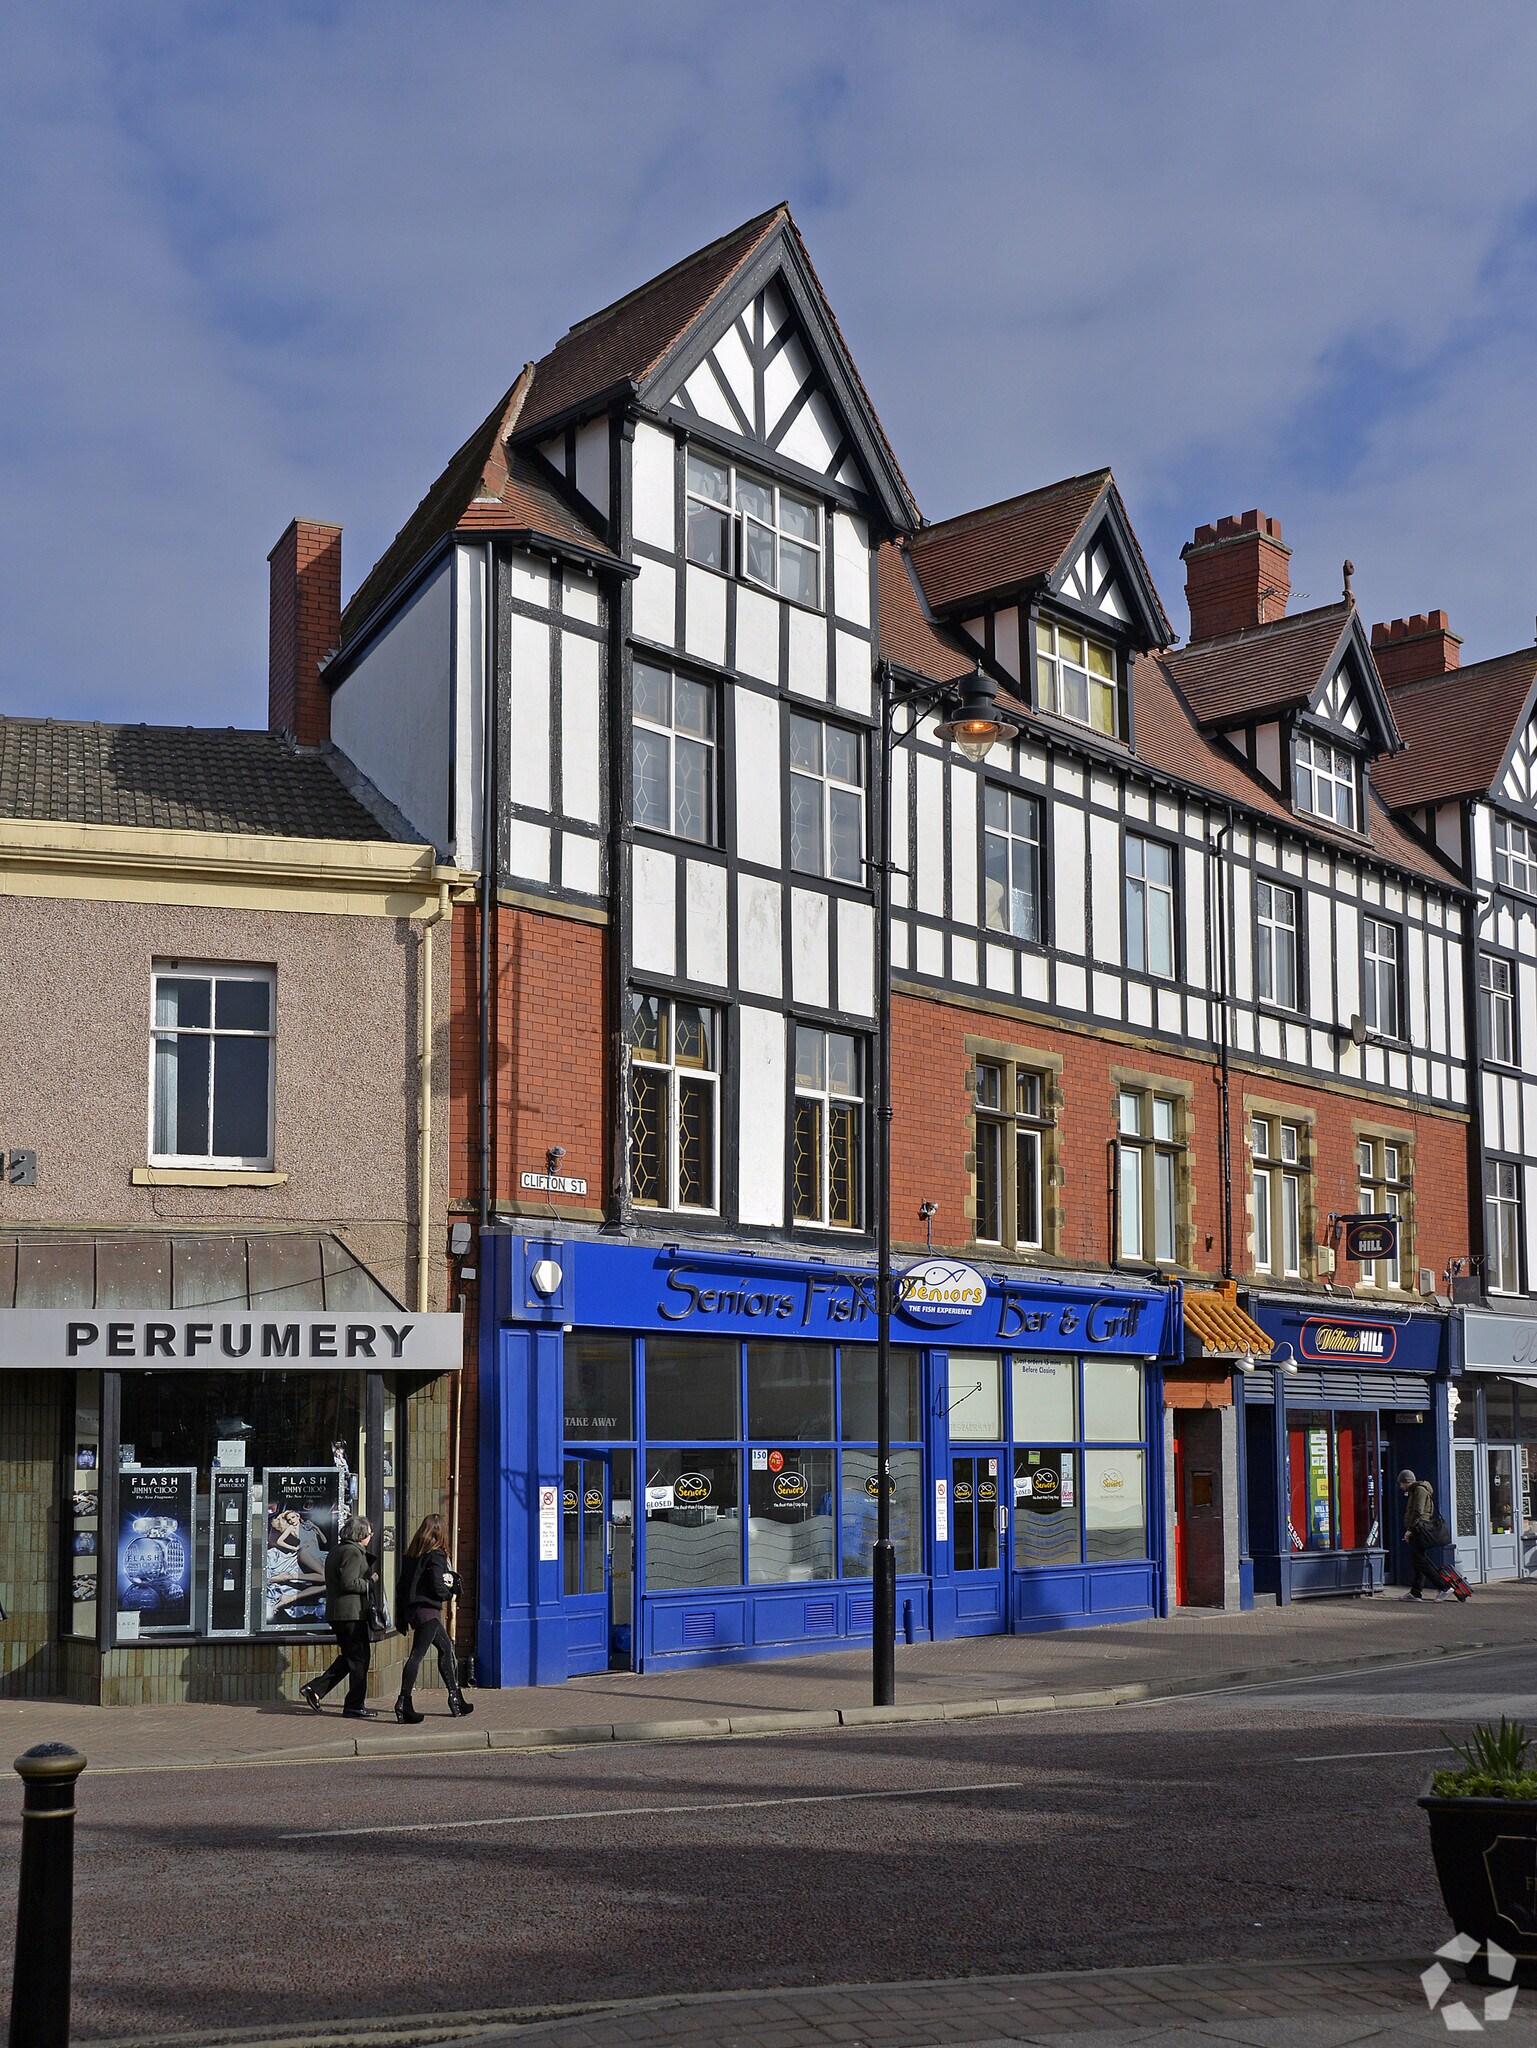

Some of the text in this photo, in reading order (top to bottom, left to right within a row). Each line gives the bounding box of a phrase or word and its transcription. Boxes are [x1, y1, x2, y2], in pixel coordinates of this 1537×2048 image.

[524, 1174, 585, 1193] CLIFTON ST.
[1359, 1240, 1382, 1252] HILL
[657, 1264, 1142, 1343] Seniors Fish Bar & Grill
[922, 1305, 936, 1313] FISH
[937, 1307, 973, 1316] EXPERIENCE
[66, 1322, 415, 1358] PERFUMERY
[1315, 1324, 1384, 1353] William HILL
[1022, 1365, 1056, 1375] Before Closing
[564, 1417, 617, 1426] TAKE AWAY
[753, 1451, 766, 1459] 150
[131, 1477, 178, 1486] FLASH
[281, 1477, 326, 1485] FLASH
[1036, 1480, 1056, 1489] Seniors
[131, 1486, 178, 1494] JIMMY CHOO
[281, 1485, 326, 1493] JIMMY CHOO
[678, 1486, 707, 1497] Seniors
[777, 1484, 804, 1495] Seniors
[646, 1500, 672, 1508] CLOSED
[127, 1554, 160, 1562] FLASH
